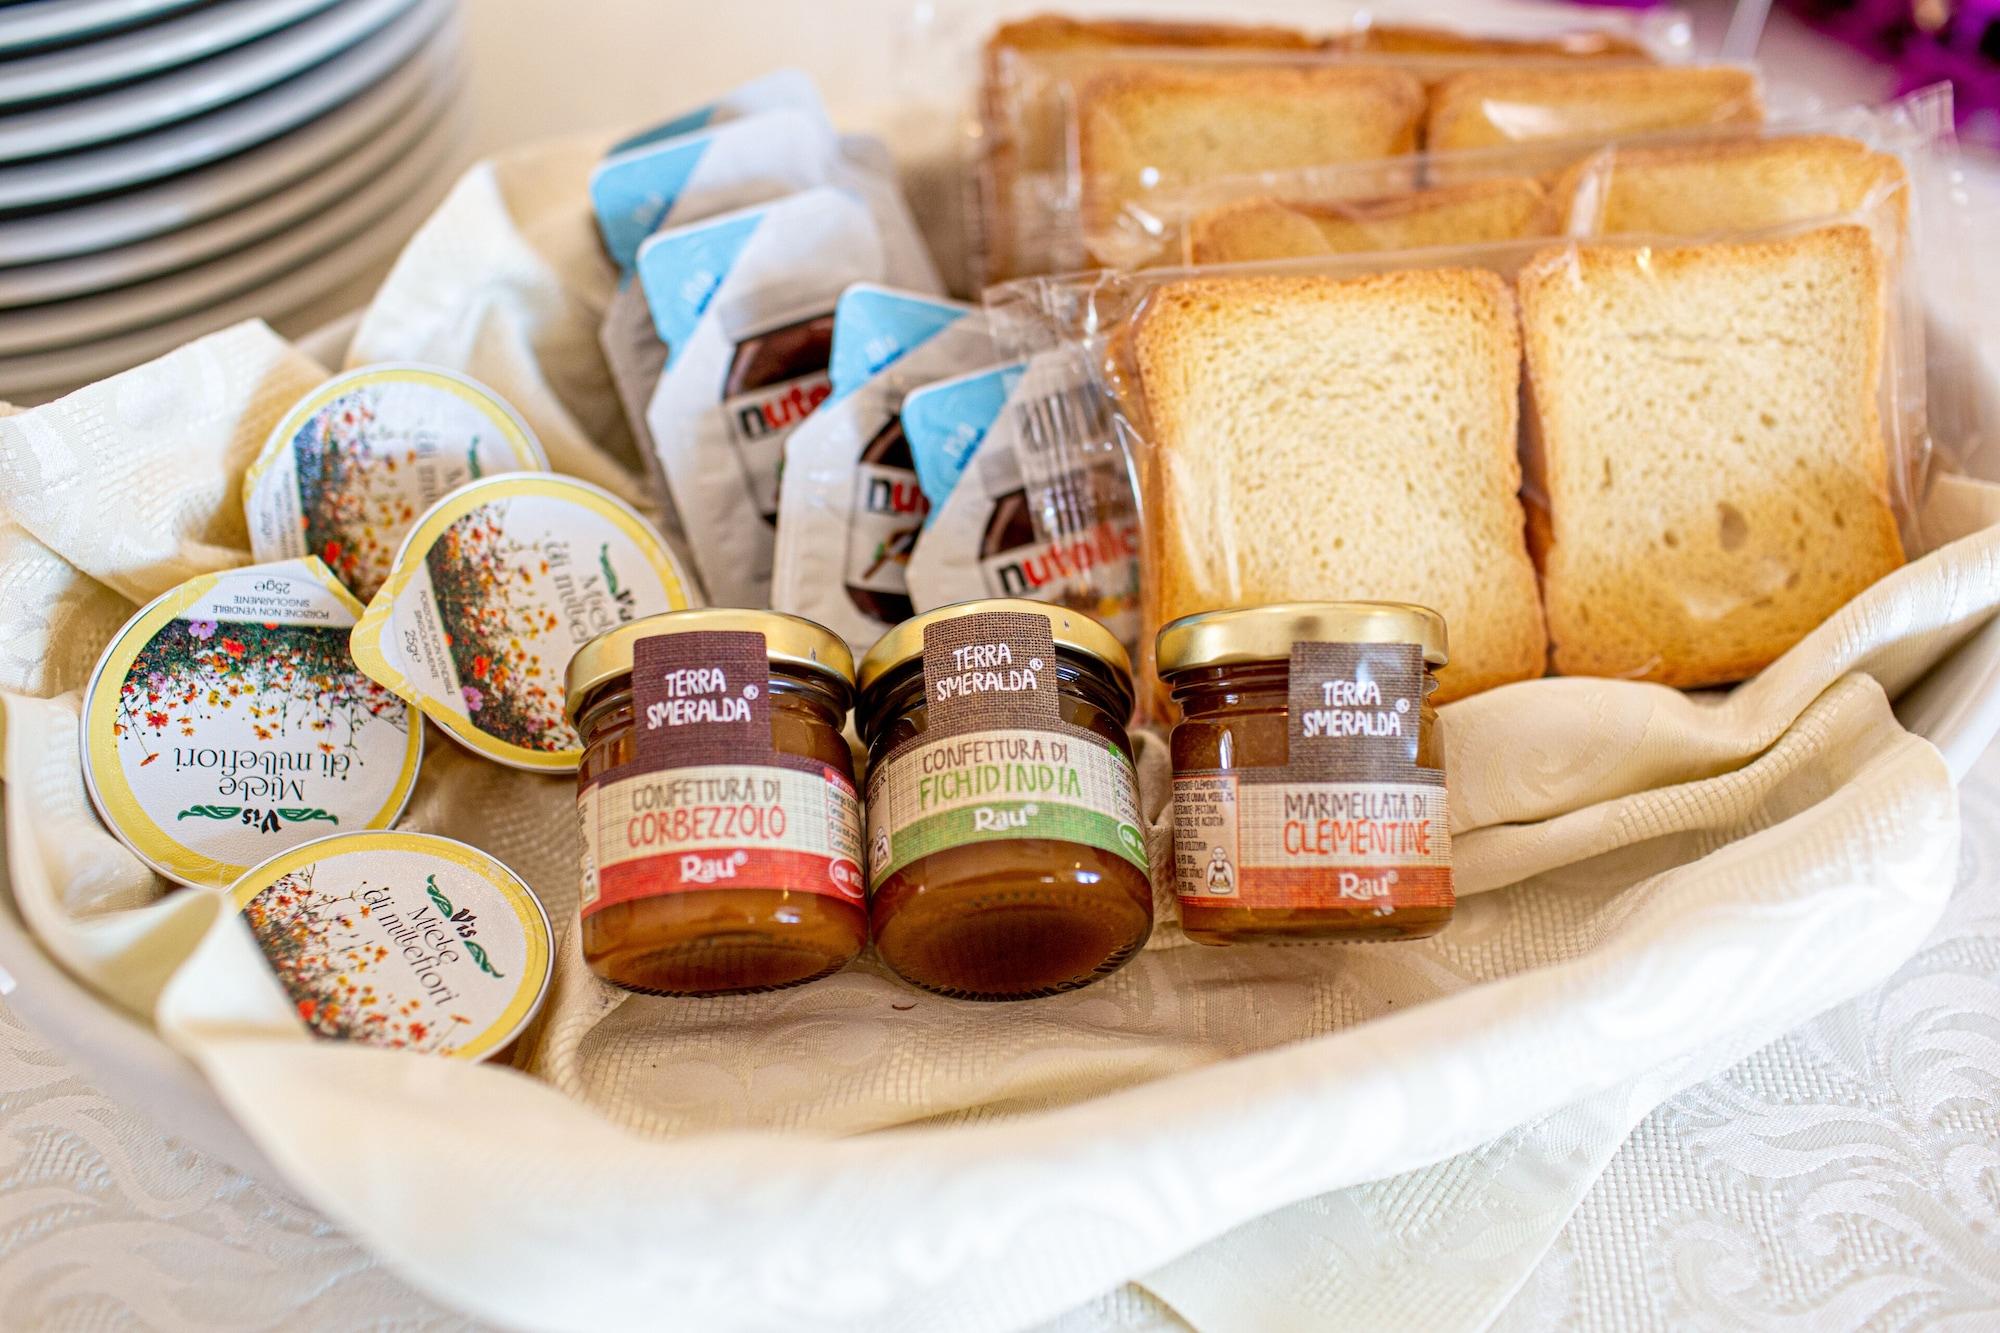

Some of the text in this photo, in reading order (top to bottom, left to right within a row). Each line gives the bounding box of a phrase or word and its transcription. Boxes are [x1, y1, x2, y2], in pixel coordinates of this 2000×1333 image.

[212, 605, 257, 616] VENDIBILE
[233, 596, 310, 607] SINGOLARMENTE
[259, 607, 282, 617] NON
[953, 643, 1012, 671] TERRA
[664, 668, 726, 697] TERRA
[1322, 680, 1382, 706] TERRA
[173, 747, 351, 780] di millefiori
[922, 739, 1068, 774] CONFETTURA DI
[218, 775, 305, 802] Miele
[632, 776, 782, 813] CONFETTURA DI
[242, 808, 282, 834] Vis
[1284, 793, 1427, 820] MARMELLATA DI
[627, 804, 785, 848] CORBEZZOLO
[1283, 819, 1431, 856] CLEMENTINE
[407, 906, 459, 965] Miele
[450, 908, 477, 938] Vis
[363, 889, 460, 1007] di millefiori
